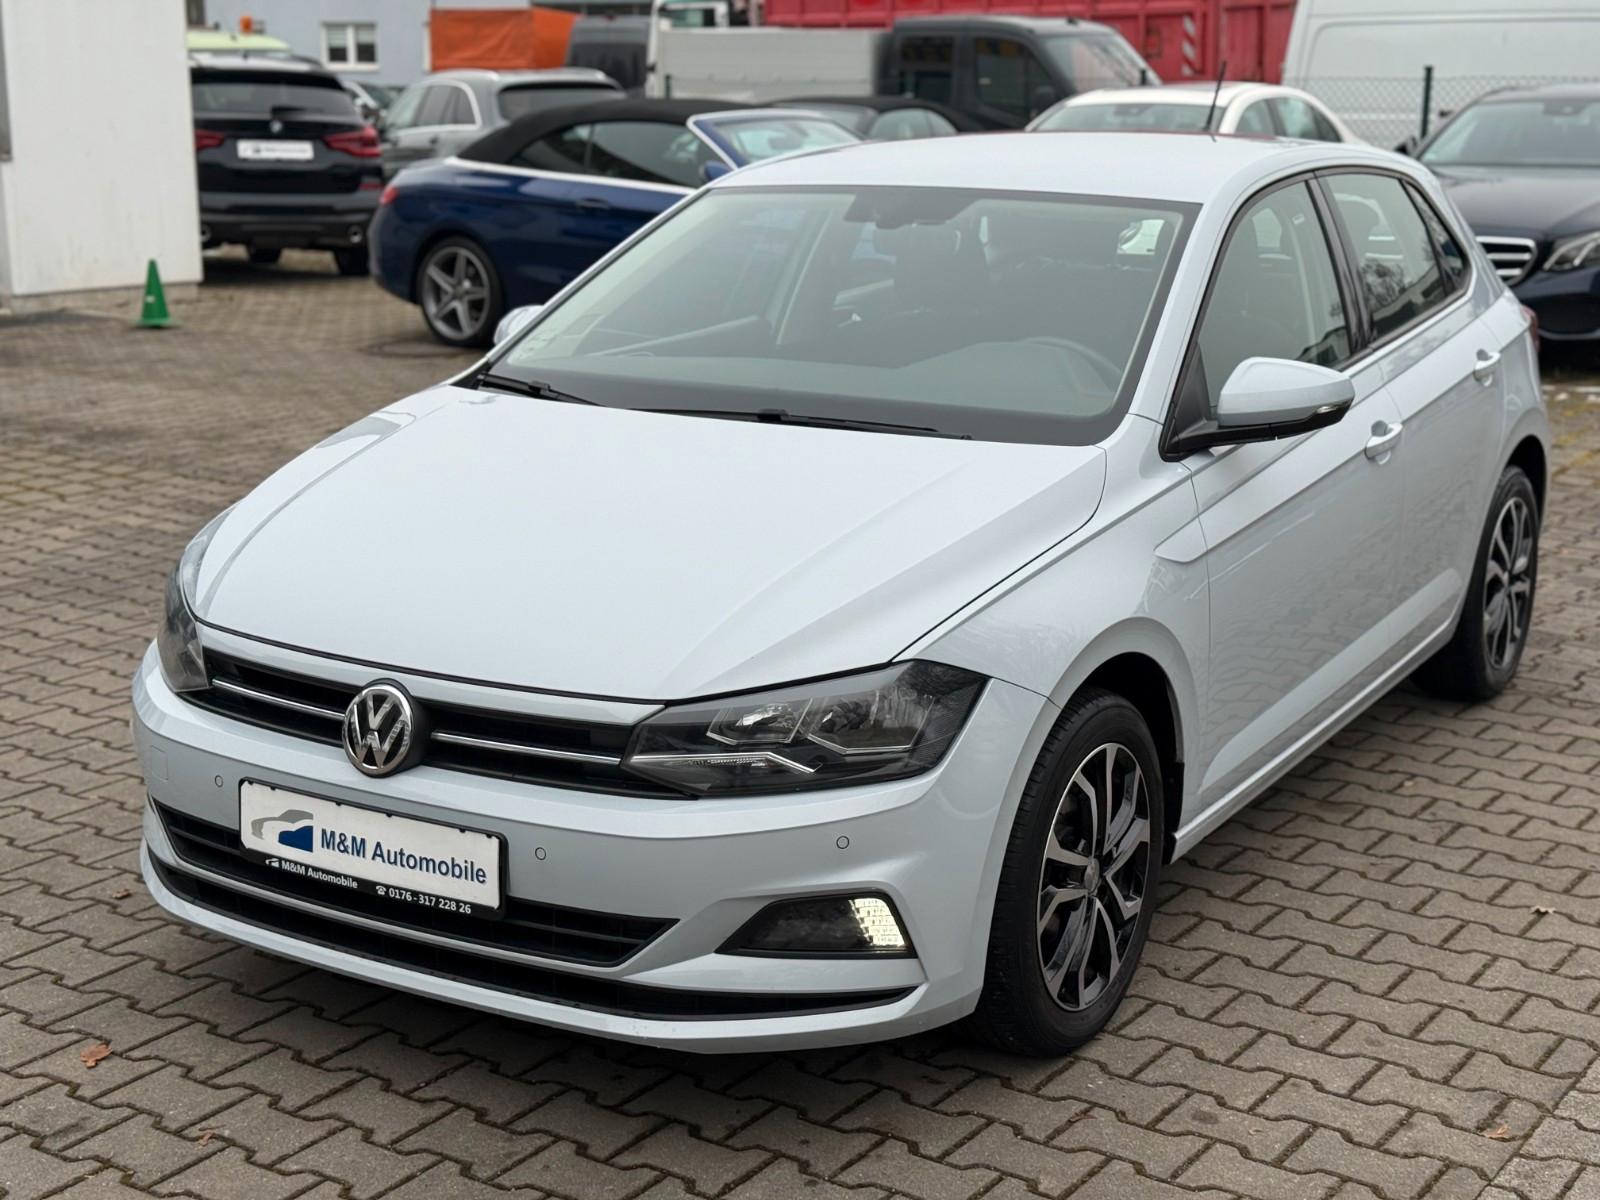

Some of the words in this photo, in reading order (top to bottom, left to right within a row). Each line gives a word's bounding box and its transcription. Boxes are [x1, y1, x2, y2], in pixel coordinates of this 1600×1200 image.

[346, 686, 411, 772] VW
[281, 860, 306, 876] M&M
[307, 867, 358, 889] Automobile
[321, 828, 366, 859] M&M
[371, 841, 487, 884] Automobile
[438, 898, 457, 911] 228
[459, 902, 472, 914] 26
